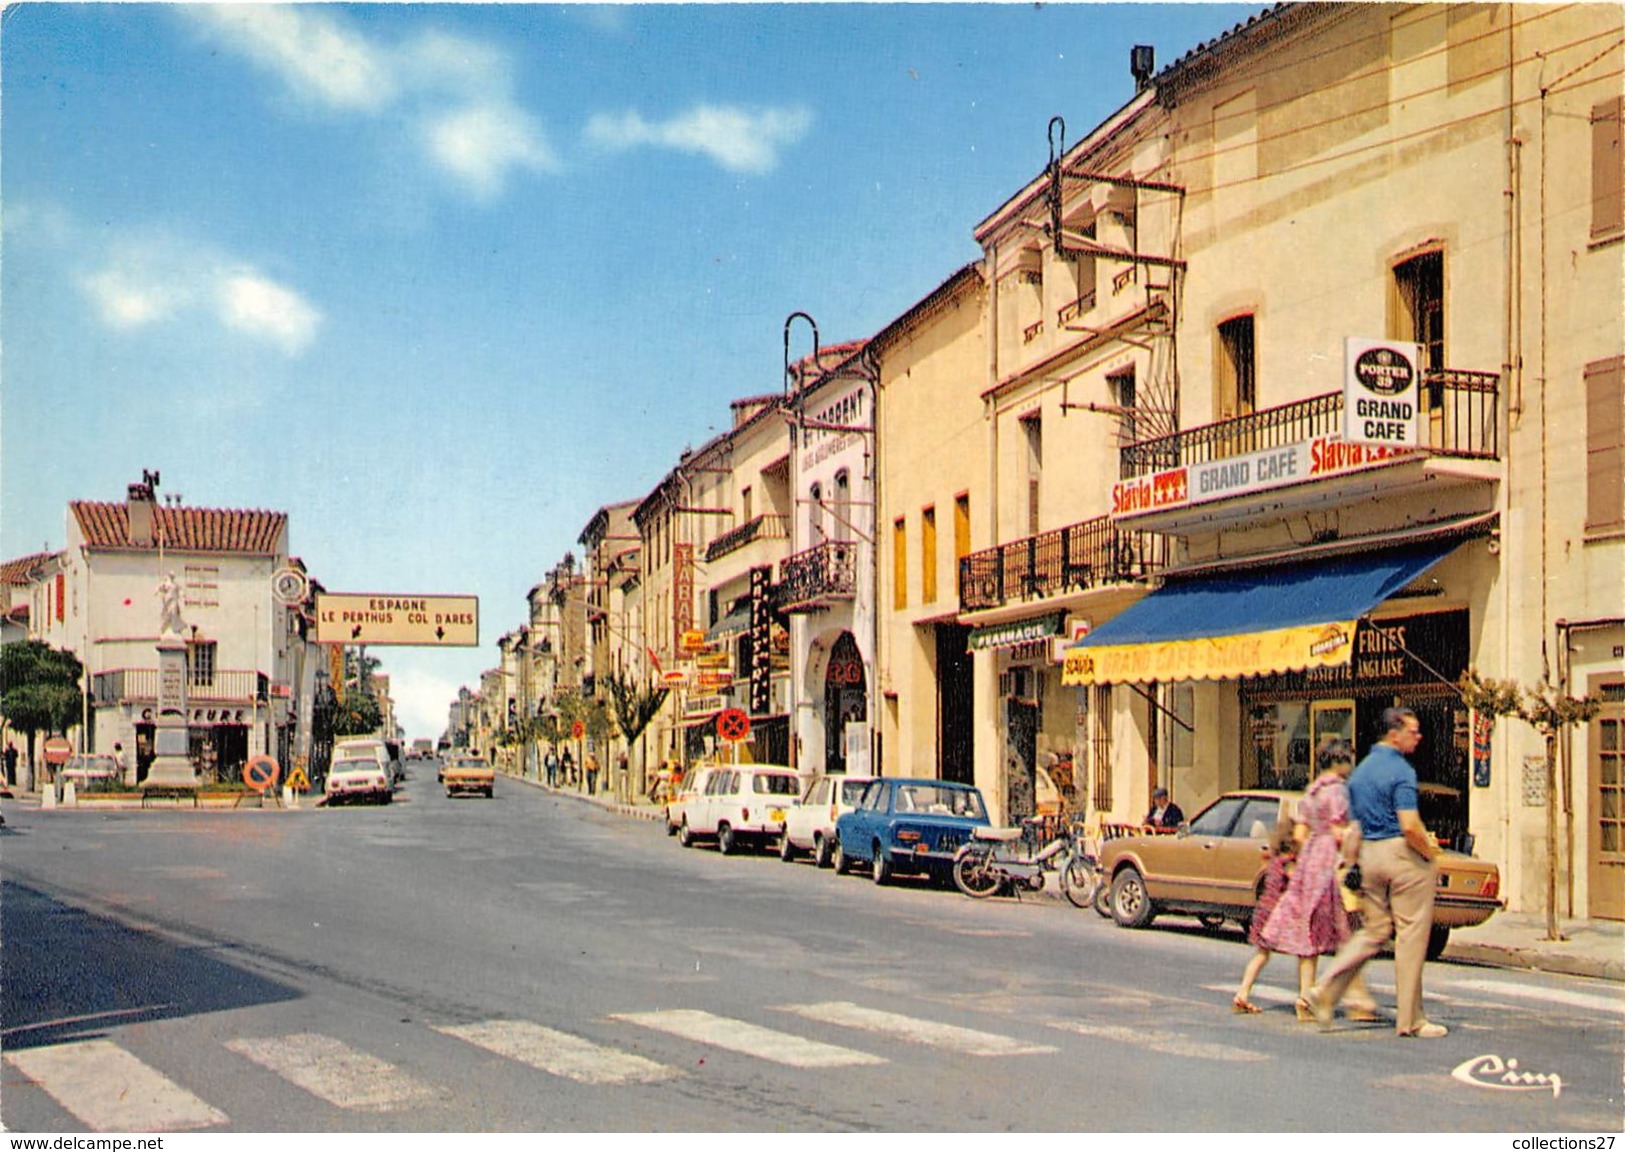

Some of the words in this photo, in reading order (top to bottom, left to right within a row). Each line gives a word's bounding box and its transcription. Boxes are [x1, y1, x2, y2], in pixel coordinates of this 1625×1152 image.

[1360, 364, 1409, 379] PORTER
[1357, 399, 1412, 420] GRAND
[1364, 421, 1405, 441] CAFE
[1310, 438, 1362, 476] Slavia
[1200, 462, 1250, 494] GRAND
[1112, 479, 1151, 513] Slavia
[369, 599, 427, 611] ESPAGNE
[321, 612, 335, 622] LE
[343, 612, 393, 623] PERTHUS
[408, 613, 428, 624] COL
[978, 624, 1044, 648] PHARMACIE
[1360, 627, 1407, 652] FRITES
[1358, 659, 1404, 677] ANGLAISE
